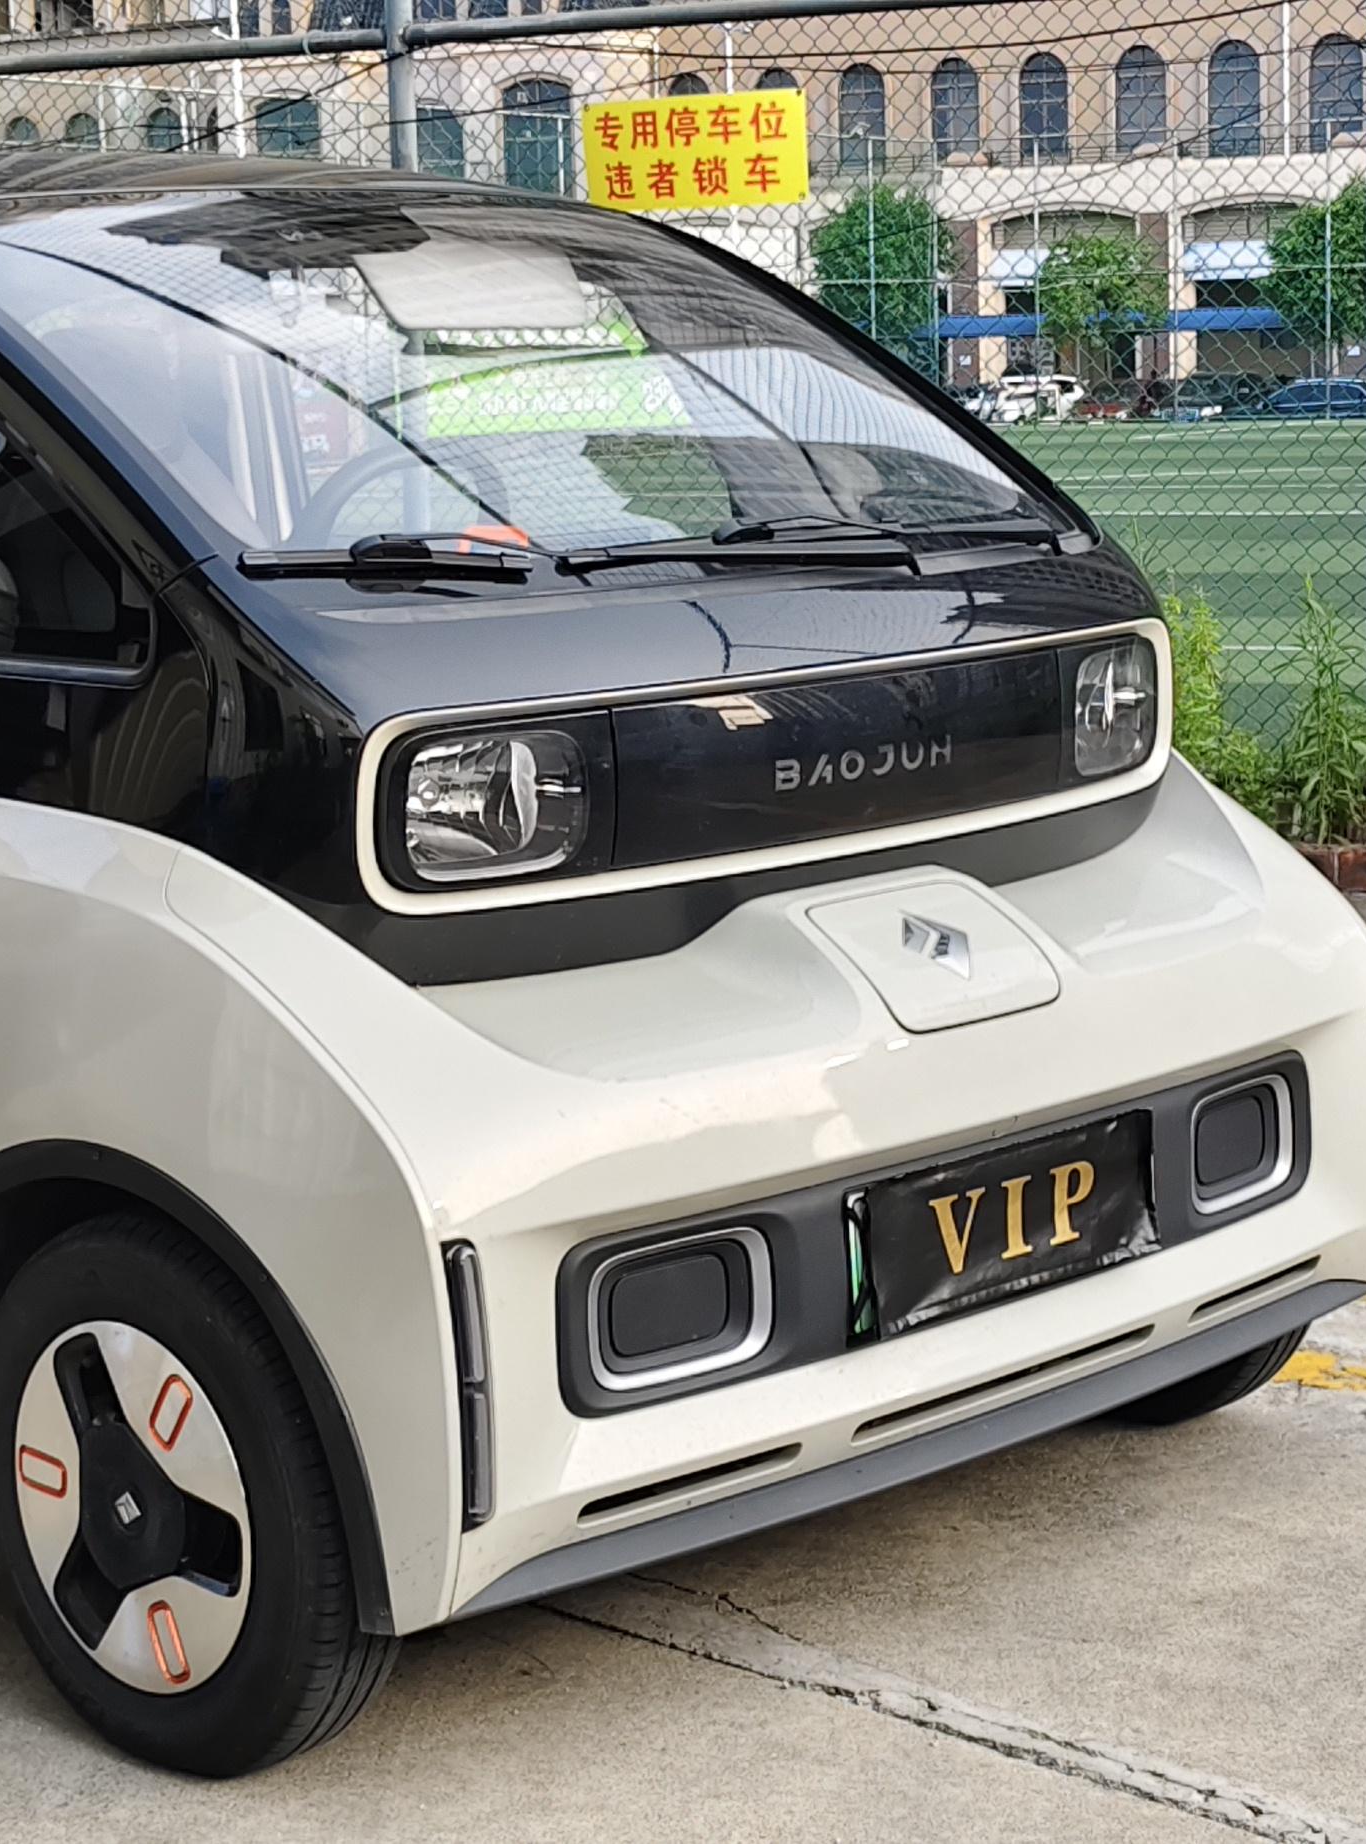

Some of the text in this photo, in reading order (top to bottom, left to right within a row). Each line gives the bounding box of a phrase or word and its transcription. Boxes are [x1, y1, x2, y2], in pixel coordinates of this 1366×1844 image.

[594, 101, 787, 151] 专用停车位
[605, 153, 780, 201] 违者锁车
[928, 1160, 1095, 1275] VIP
